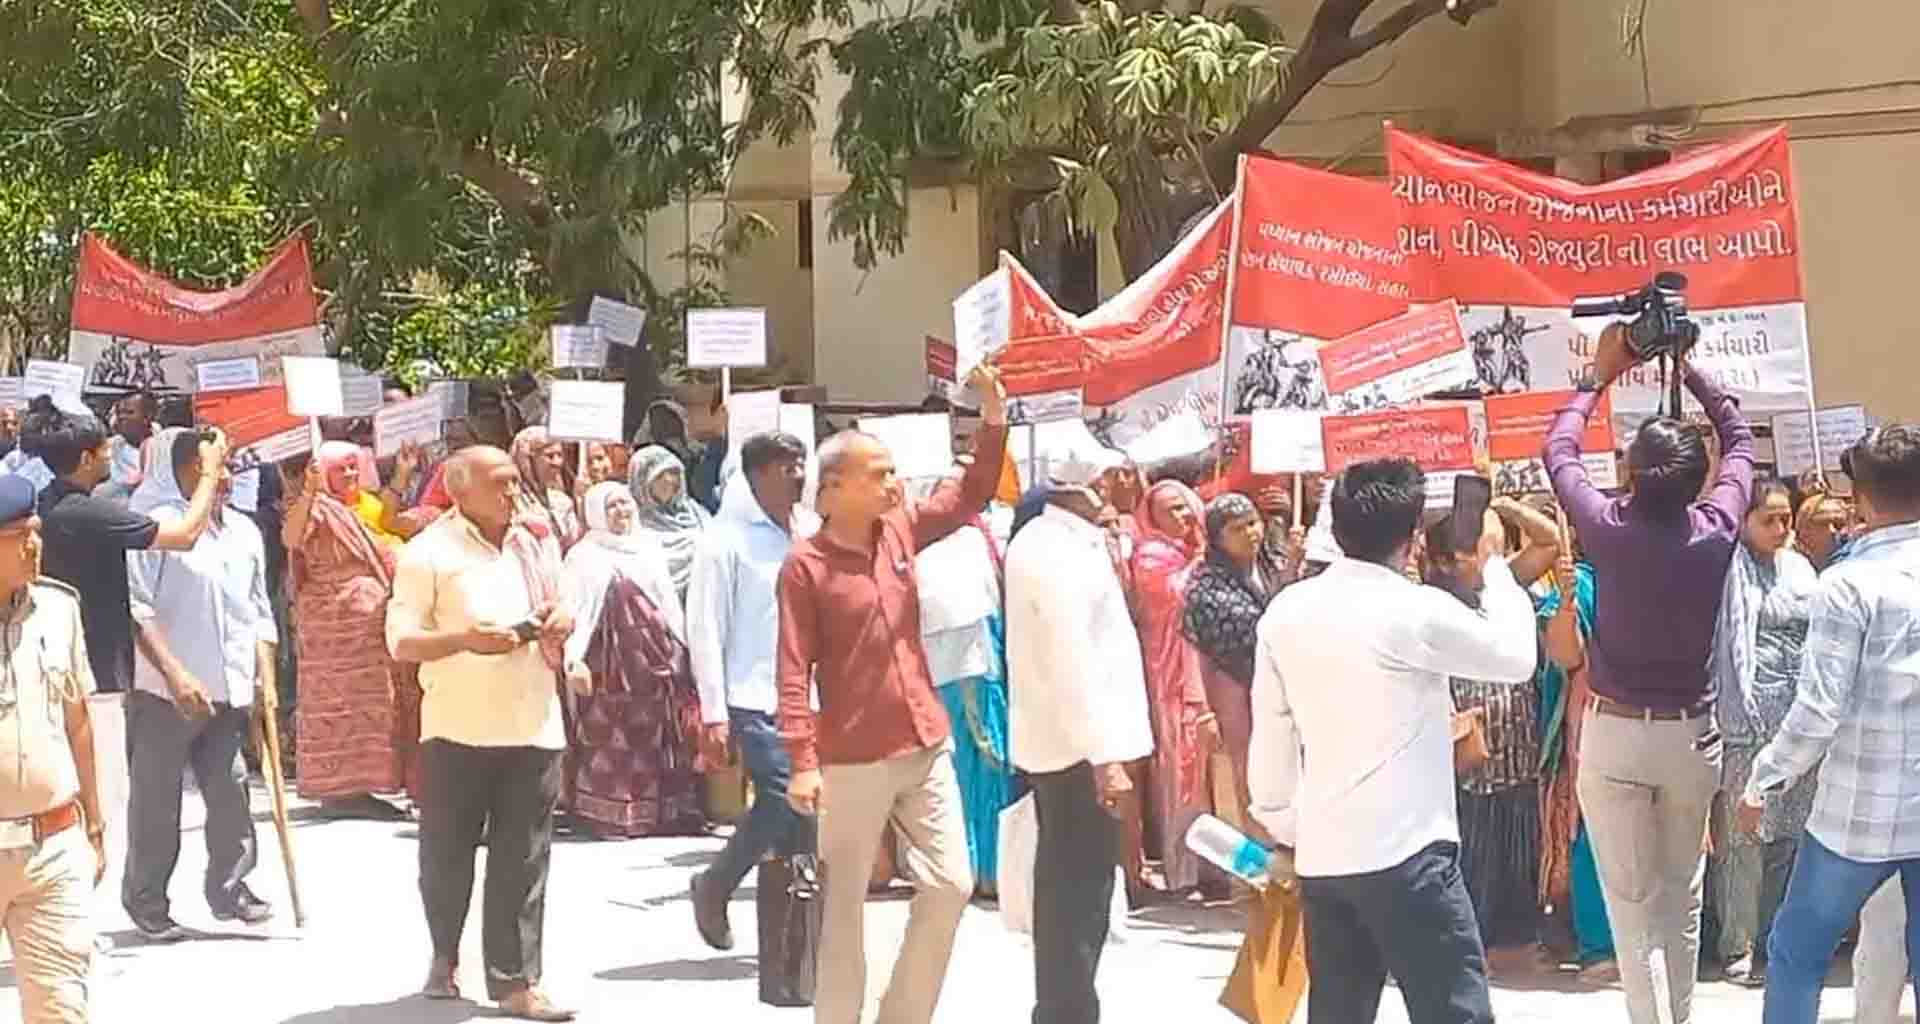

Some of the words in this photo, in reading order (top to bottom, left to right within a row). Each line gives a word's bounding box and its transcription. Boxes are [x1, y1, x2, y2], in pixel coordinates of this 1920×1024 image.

[1527, 192, 1634, 223] યોજનાના
[1642, 170, 1786, 222] કર્મચારીઓને
[1654, 235, 1711, 266] લાભ
[1716, 218, 1794, 261] આપો.
[1704, 330, 1770, 358] કર્મચારી
